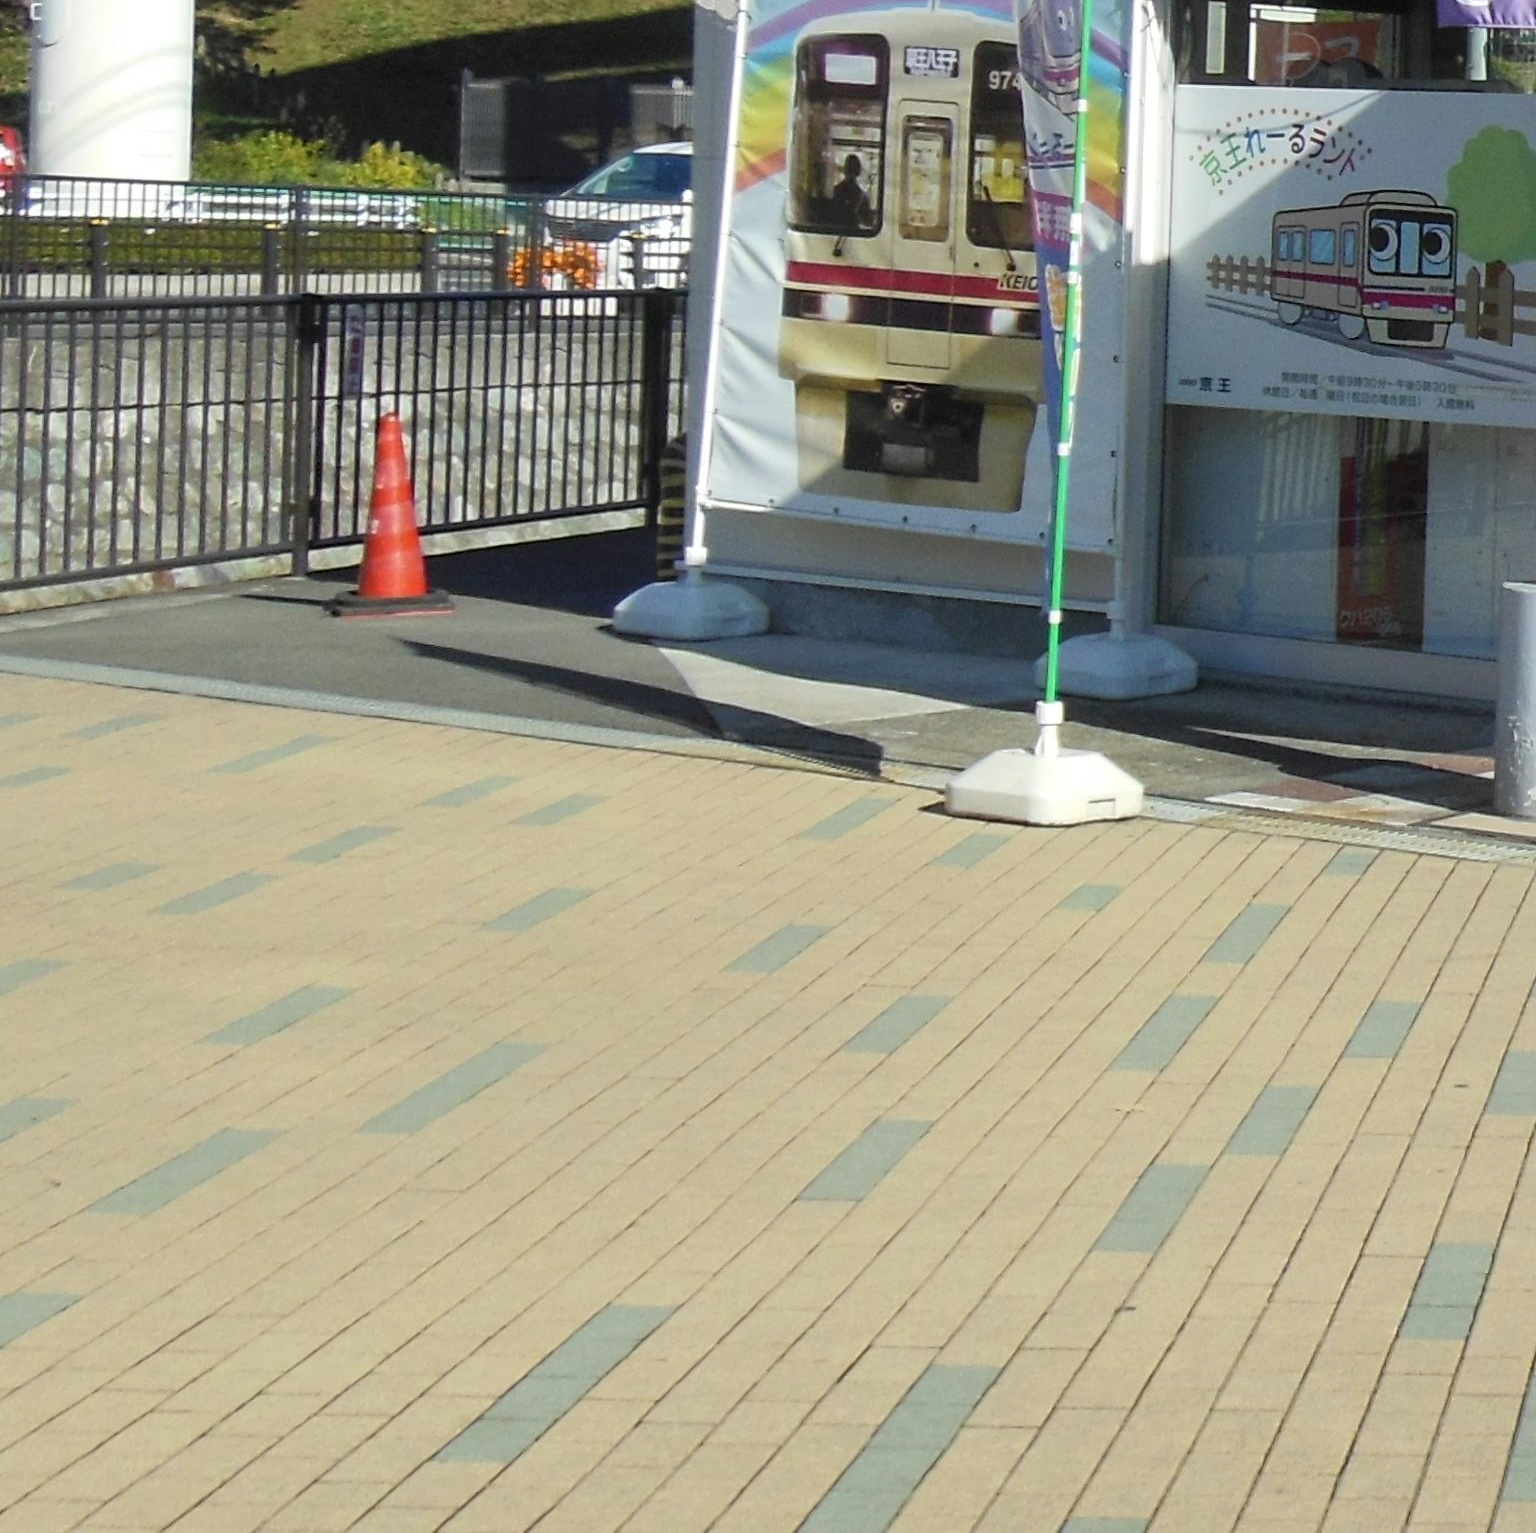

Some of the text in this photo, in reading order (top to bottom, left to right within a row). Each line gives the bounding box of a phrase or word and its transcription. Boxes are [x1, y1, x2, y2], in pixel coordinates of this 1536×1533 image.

[1200, 123, 1364, 186] 京王れーるランド
